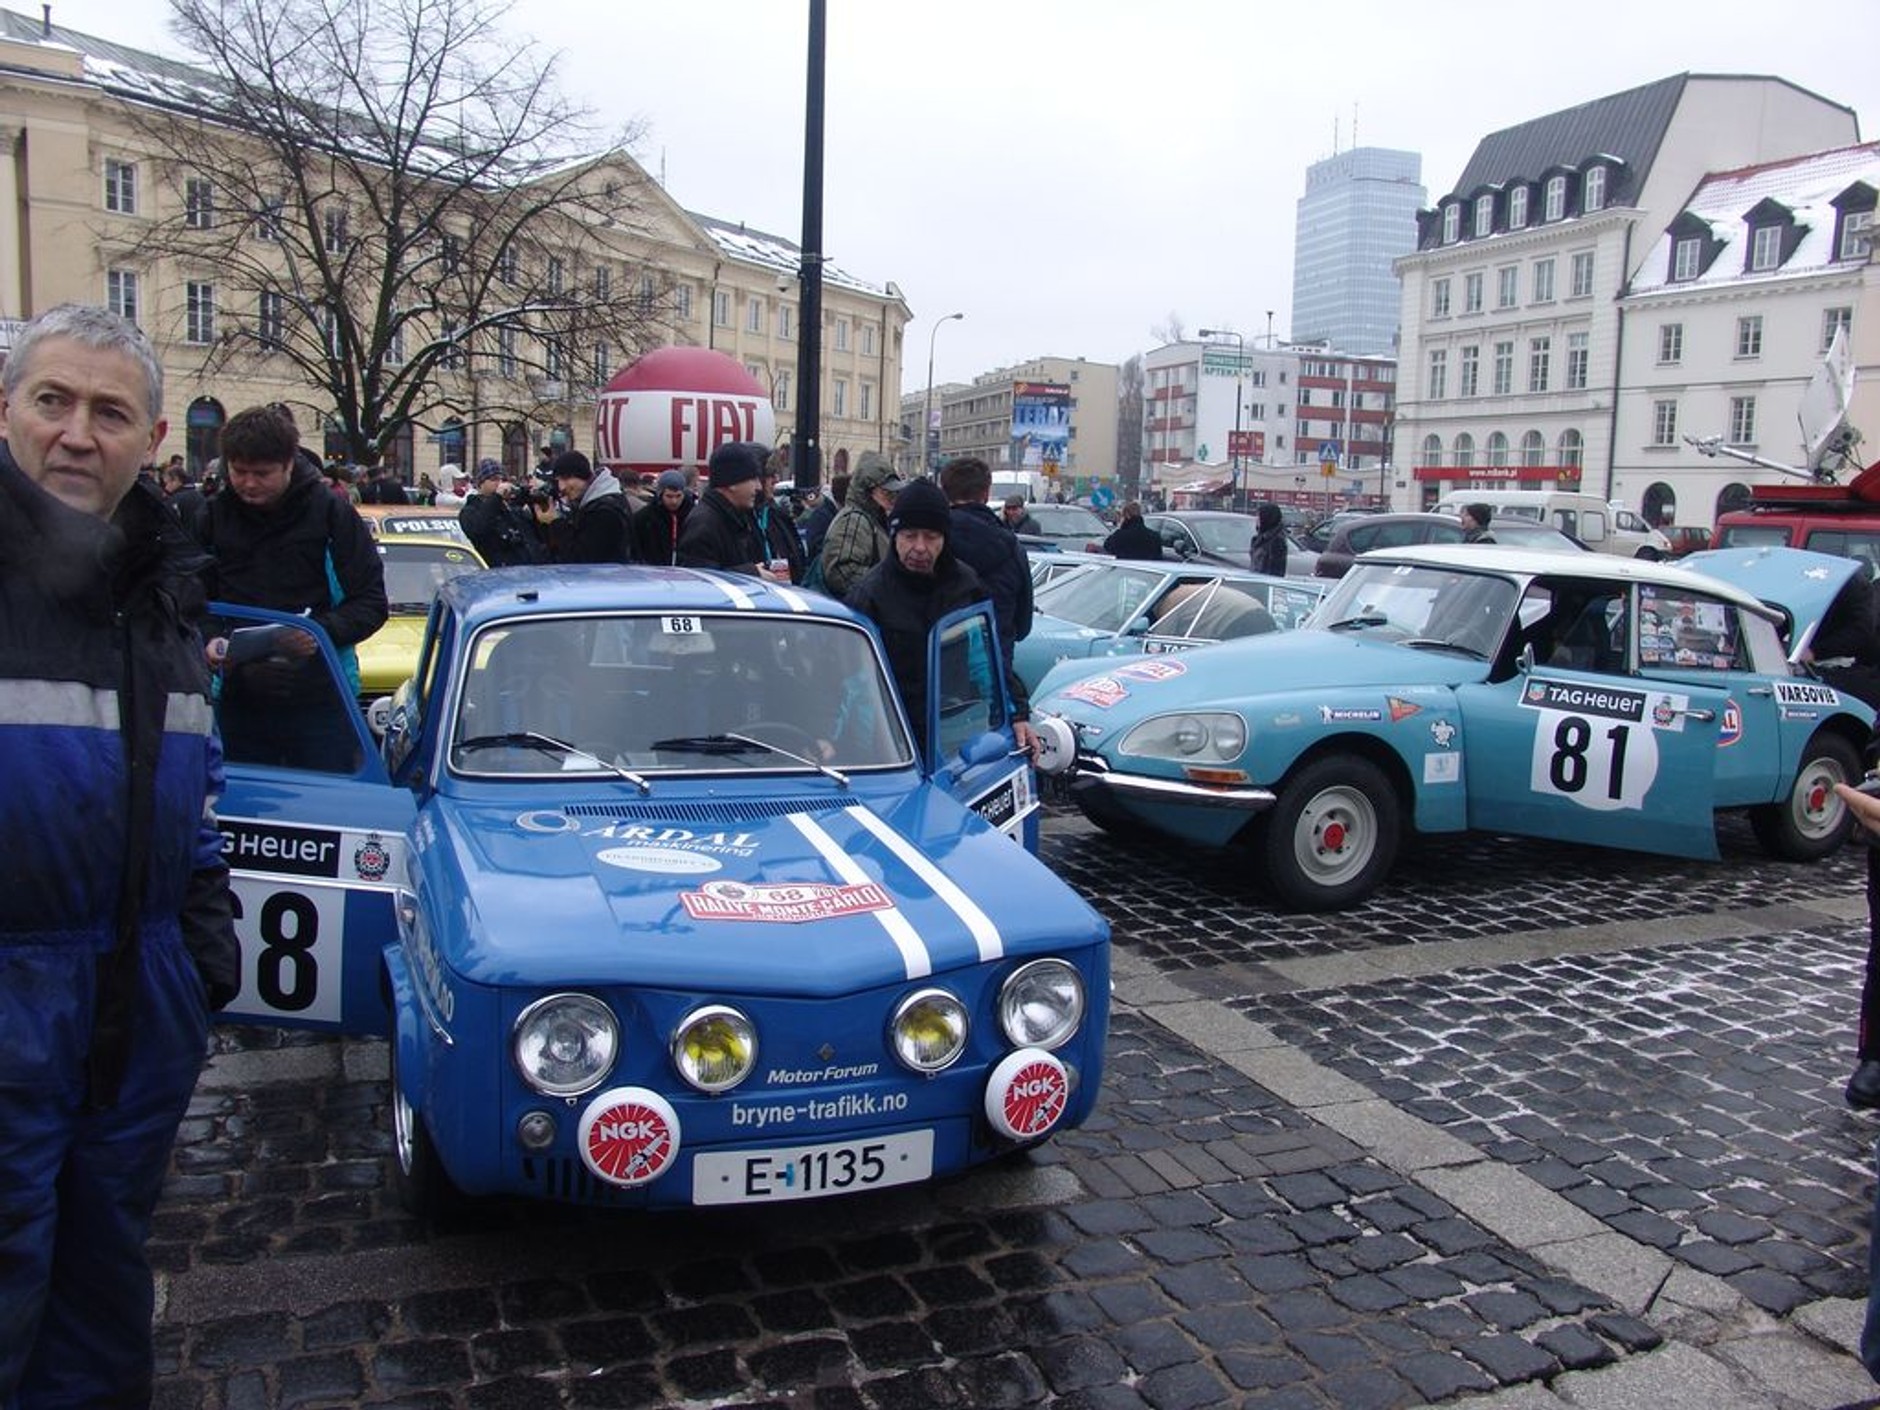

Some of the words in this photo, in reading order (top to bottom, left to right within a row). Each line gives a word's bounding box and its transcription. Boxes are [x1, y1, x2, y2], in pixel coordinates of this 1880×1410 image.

[672, 397, 757, 461] FIAT
[671, 618, 694, 633] 68
[1777, 684, 1836, 704] VARSOVIE
[1332, 710, 1381, 721] MICHELIN
[1550, 716, 1630, 800] 81
[692, 893, 754, 914] RALLYE
[1013, 1075, 1056, 1102] NGK
[732, 1092, 908, 1129] bryne-trafikk.no
[601, 1120, 657, 1142] NGK
